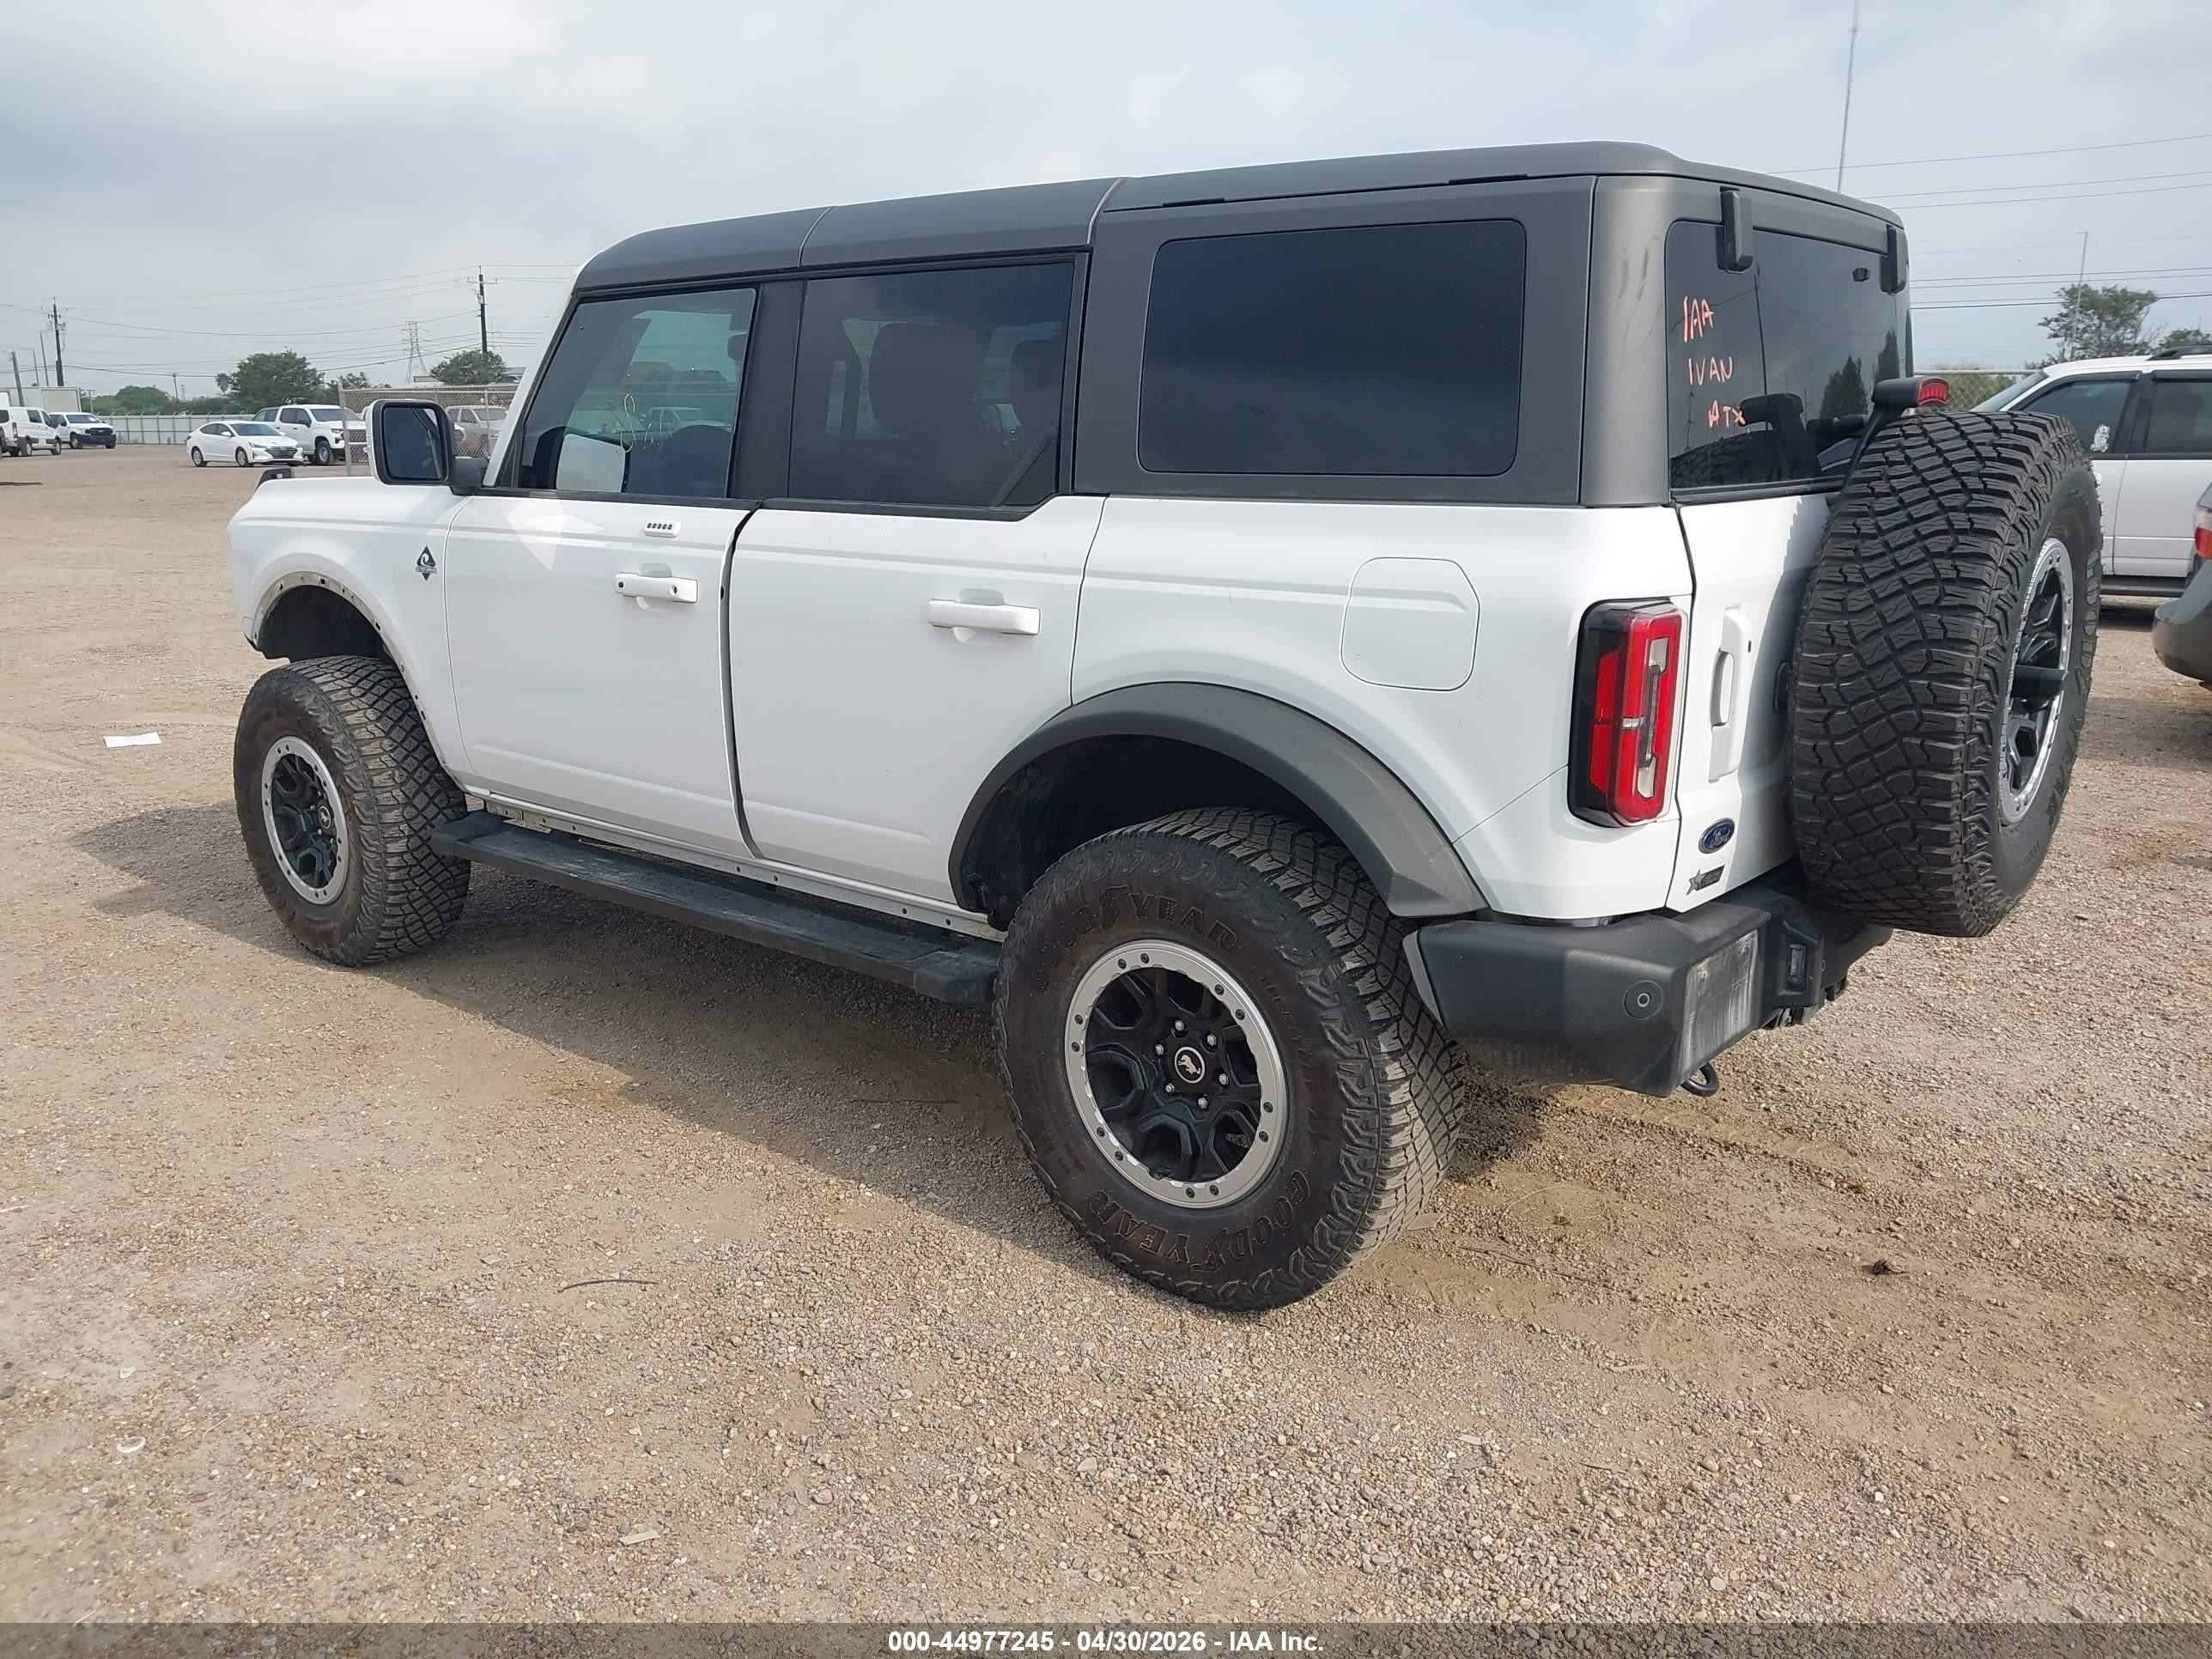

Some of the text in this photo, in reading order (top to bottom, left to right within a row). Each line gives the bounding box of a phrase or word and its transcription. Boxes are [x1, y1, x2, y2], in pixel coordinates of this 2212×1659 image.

[1683, 295, 1715, 343] IAA
[1688, 356, 1734, 386] IVAN
[1708, 399, 1746, 428] ATX
[1089, 1170, 1310, 1272] GOODYEAR
